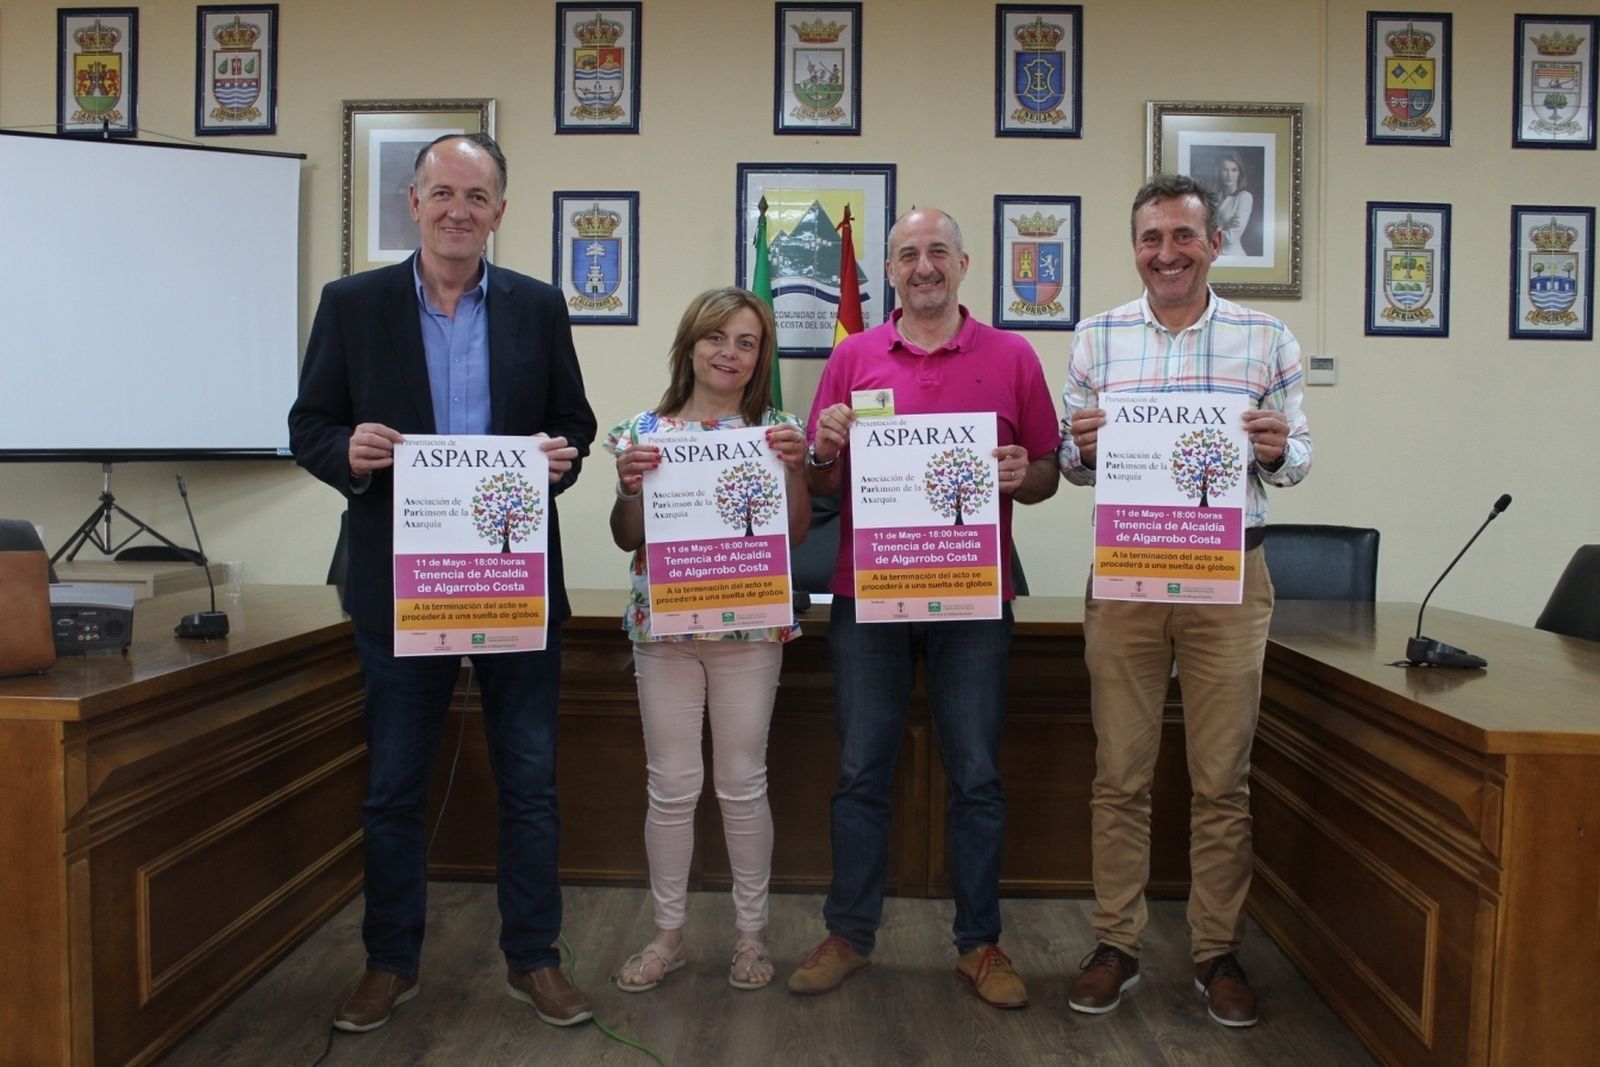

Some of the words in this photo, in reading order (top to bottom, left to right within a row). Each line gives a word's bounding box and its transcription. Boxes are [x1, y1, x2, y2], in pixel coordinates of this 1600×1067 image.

[1024, 111, 1054, 121] NERJA
[1021, 303, 1053, 315] TORROX
[780, 320, 803, 329] COSTA
[805, 320, 818, 329] DEL
[1115, 406, 1226, 424] ASPARAX
[867, 426, 976, 447] ASPARAX
[661, 440, 763, 463] ASPARAX
[412, 449, 526, 468] ASPARAX
[1148, 462, 1158, 470] de
[1160, 462, 1167, 470] la
[861, 474, 902, 482] Asociación
[1106, 473, 1141, 481] Axarquía
[652, 490, 693, 498] Asociación
[861, 485, 901, 493] Parkinson
[653, 500, 692, 508] Parkinson
[861, 496, 896, 504] Axarquía
[653, 511, 688, 520] Axarquía
[1141, 511, 1165, 519] Mayo
[404, 521, 441, 530] Axarquía
[1113, 520, 1162, 530] Tenencia
[1166, 522, 1178, 530] de
[1182, 522, 1225, 532] Alcaldía
[899, 532, 922, 540] Mayo
[1116, 533, 1130, 542] de
[1133, 533, 1187, 544] Algarrobo
[1190, 534, 1221, 544] Costa
[691, 544, 713, 553] Mayo
[721, 542, 743, 550] 18:00
[872, 542, 920, 551] Tenencia
[923, 541, 935, 550] de
[939, 540, 981, 550] Alcaldía
[664, 554, 712, 566] Tenencia
[715, 553, 727, 562] de
[730, 550, 771, 561] Alcaldía
[875, 556, 888, 564] de
[892, 554, 945, 565] Algarrobo
[947, 553, 978, 562] Costa
[1129, 552, 1178, 560] terminación
[442, 559, 466, 568] Mayo
[1101, 561, 1144, 569] procederá
[1208, 564, 1235, 572] globos
[413, 570, 464, 579] Tenencia
[467, 570, 480, 578] de
[484, 569, 528, 578] Alcaldía
[669, 569, 682, 578] de
[685, 565, 736, 578] Algarrobo
[739, 563, 768, 573] Costa
[417, 584, 431, 592] de
[434, 583, 490, 594] Algarrobo
[493, 582, 524, 591] Costa
[683, 583, 729, 593] terminación
[862, 583, 903, 592] procederá
[966, 580, 992, 588] globos
[656, 594, 697, 605] procederá
[722, 591, 745, 599] suelta
[758, 589, 784, 598] globos
[402, 613, 446, 622] procederá
[512, 611, 539, 619] globos
